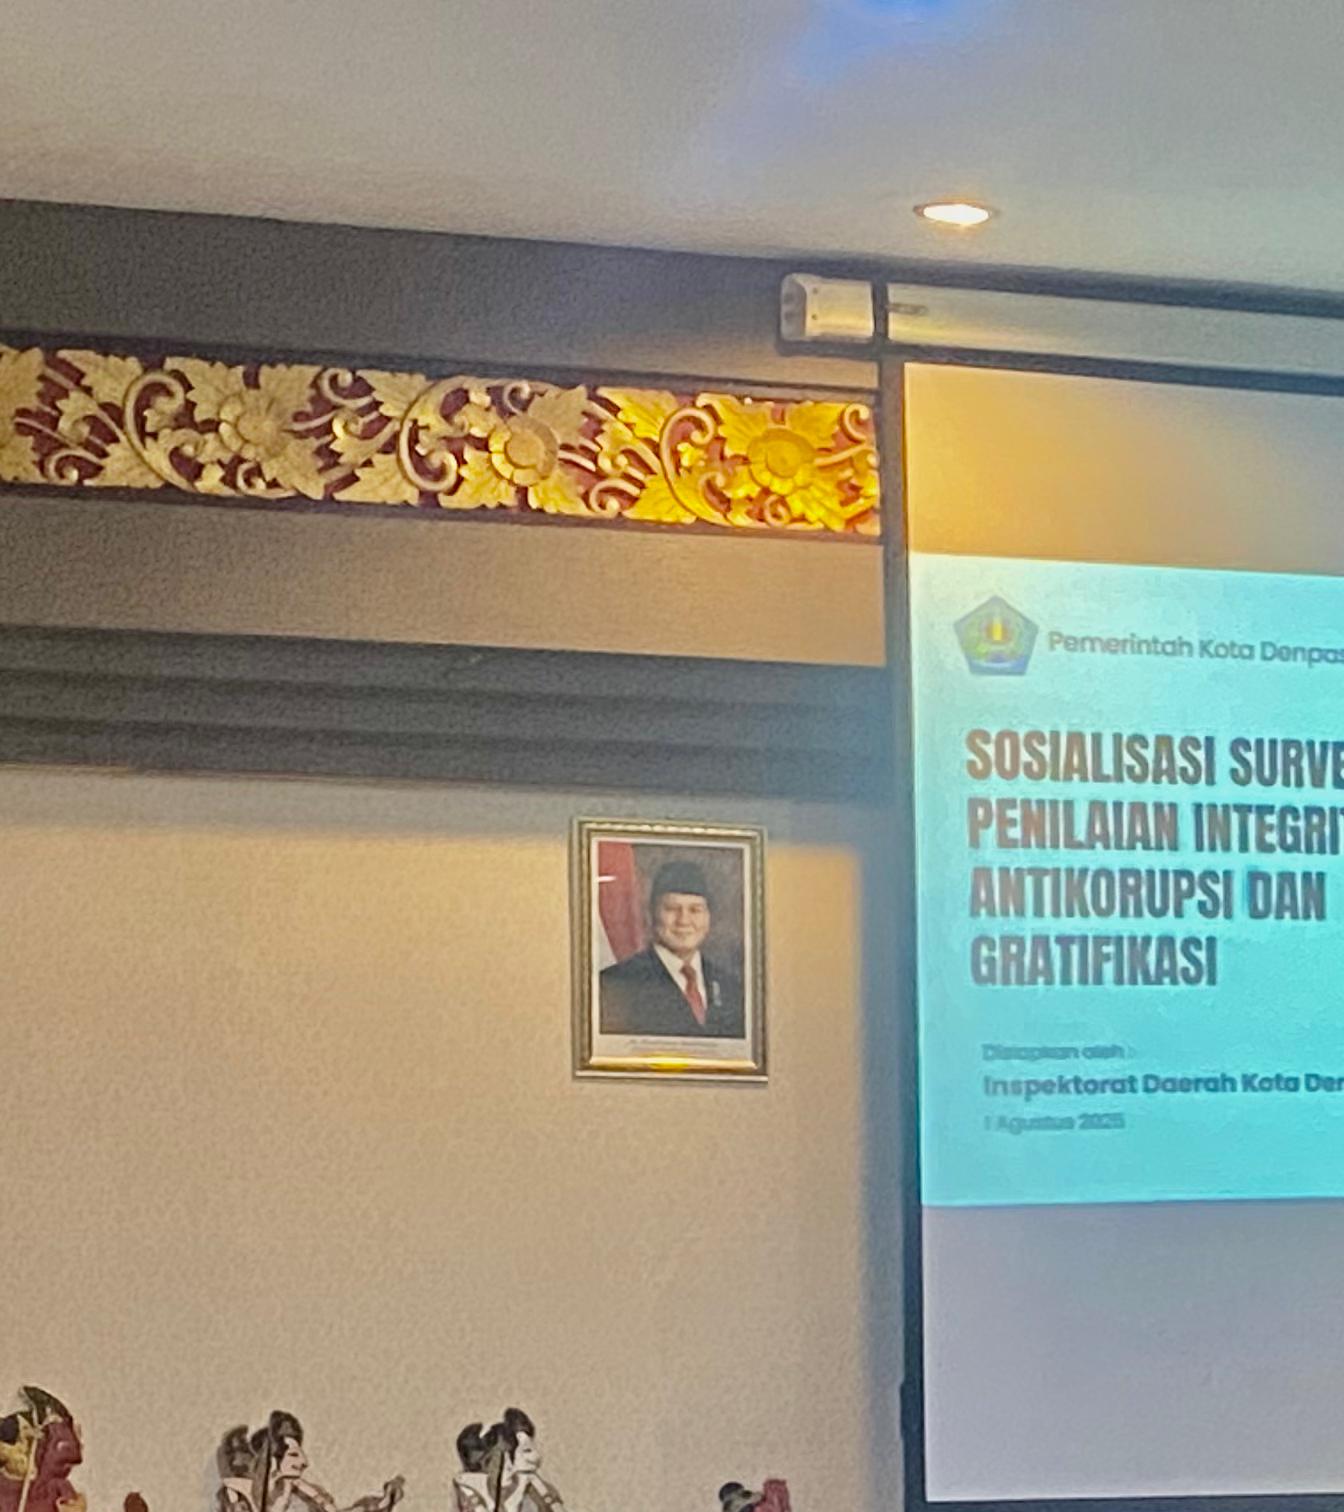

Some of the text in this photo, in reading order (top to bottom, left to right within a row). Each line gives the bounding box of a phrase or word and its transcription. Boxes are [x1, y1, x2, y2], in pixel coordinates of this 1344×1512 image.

[1048, 630, 1193, 658] Pemerintah
[1199, 638, 1255, 661] Kota
[966, 728, 1216, 786] SOSIALISASI
[967, 797, 1179, 852] PENILAIAN
[969, 866, 1327, 920] ANTIKORUPSI DAN
[971, 934, 1218, 986] GRATIFIKASI
[984, 1074, 1138, 1102] Inspektorat
[1142, 1073, 1238, 1094] Daerah
[1241, 1073, 1300, 1093] Kota
